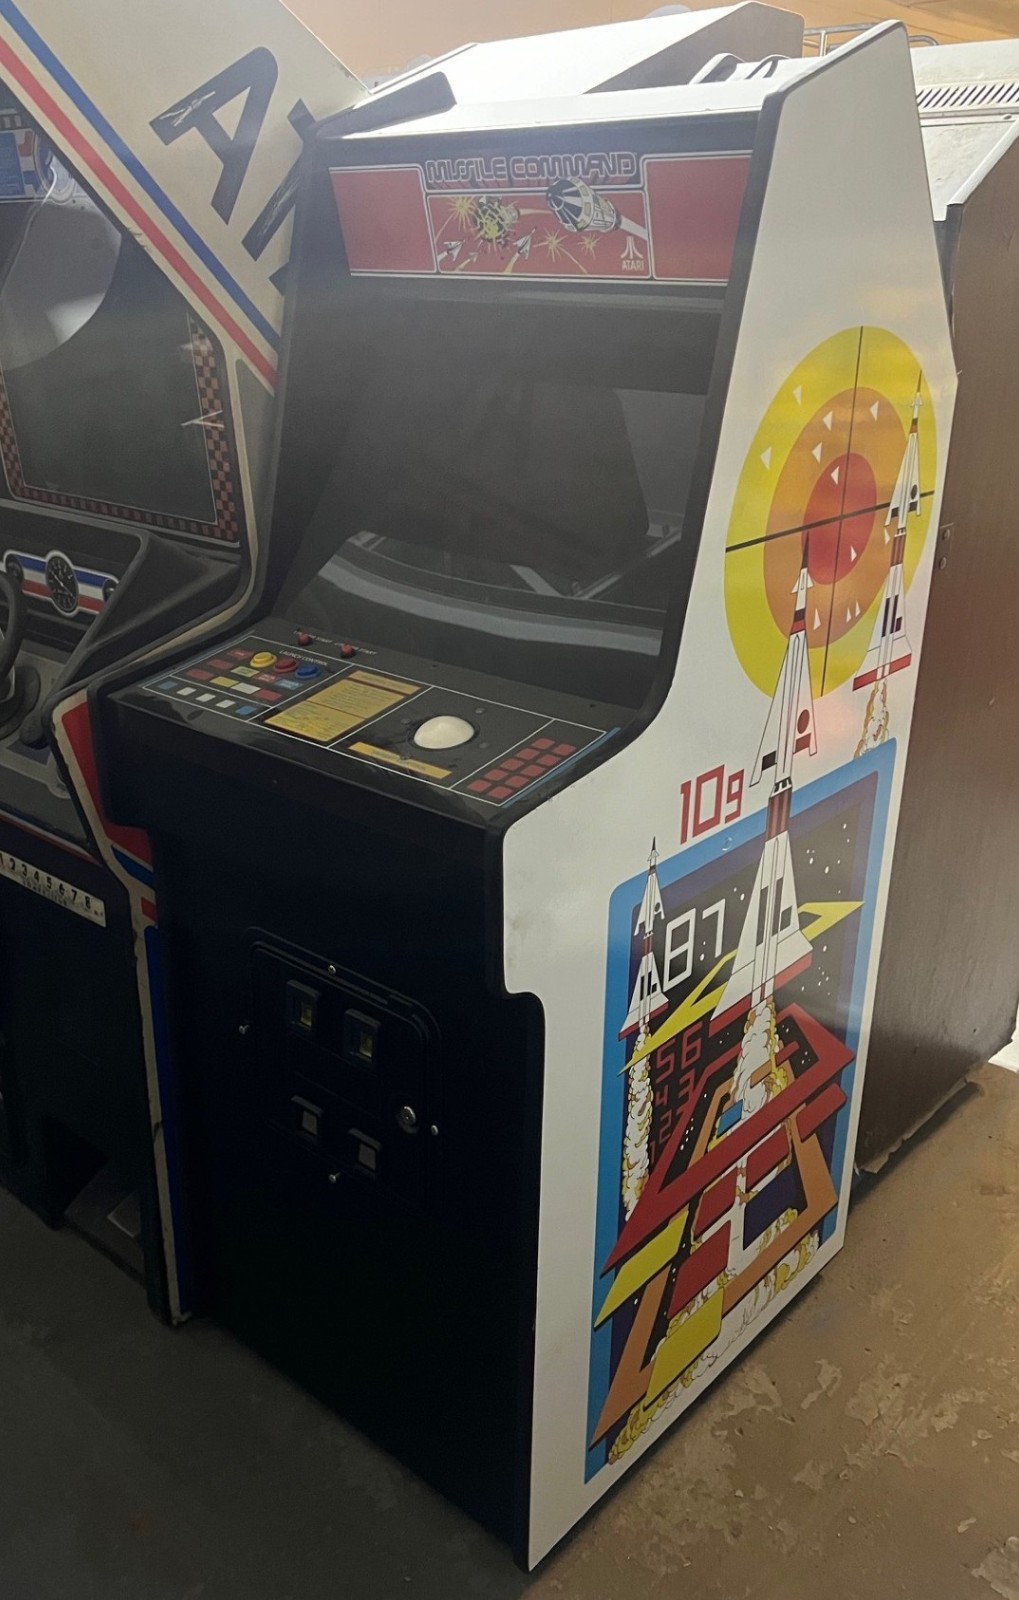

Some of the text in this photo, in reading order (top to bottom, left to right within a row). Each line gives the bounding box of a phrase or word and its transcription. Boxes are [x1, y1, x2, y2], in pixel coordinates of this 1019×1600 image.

[424, 152, 638, 186] MISSILE COMMAND
[621, 259, 645, 271] ATARI
